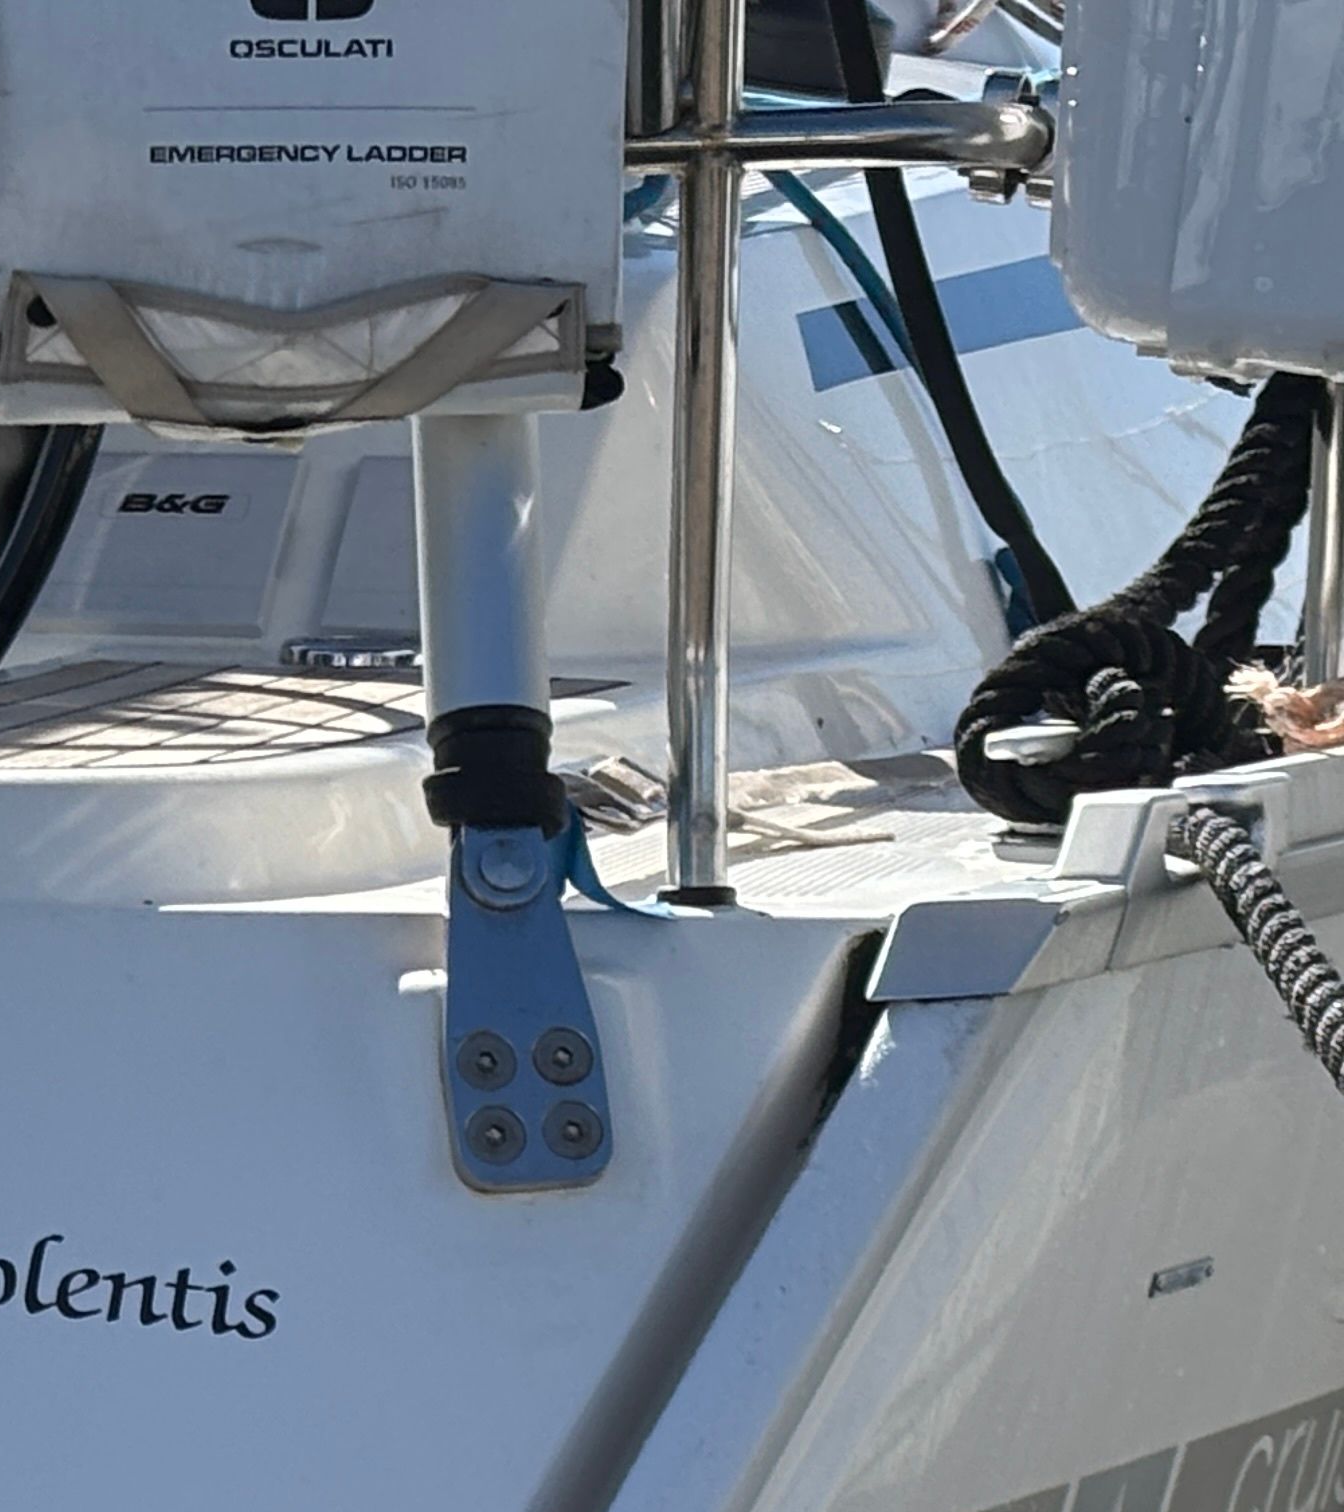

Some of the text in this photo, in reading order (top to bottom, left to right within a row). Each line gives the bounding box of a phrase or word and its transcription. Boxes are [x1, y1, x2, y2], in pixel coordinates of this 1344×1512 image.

[229, 38, 394, 59] OSCULATI
[149, 144, 467, 164] EMERGENCY LADDER
[390, 175, 417, 189] ISO
[116, 493, 231, 514] B&G
